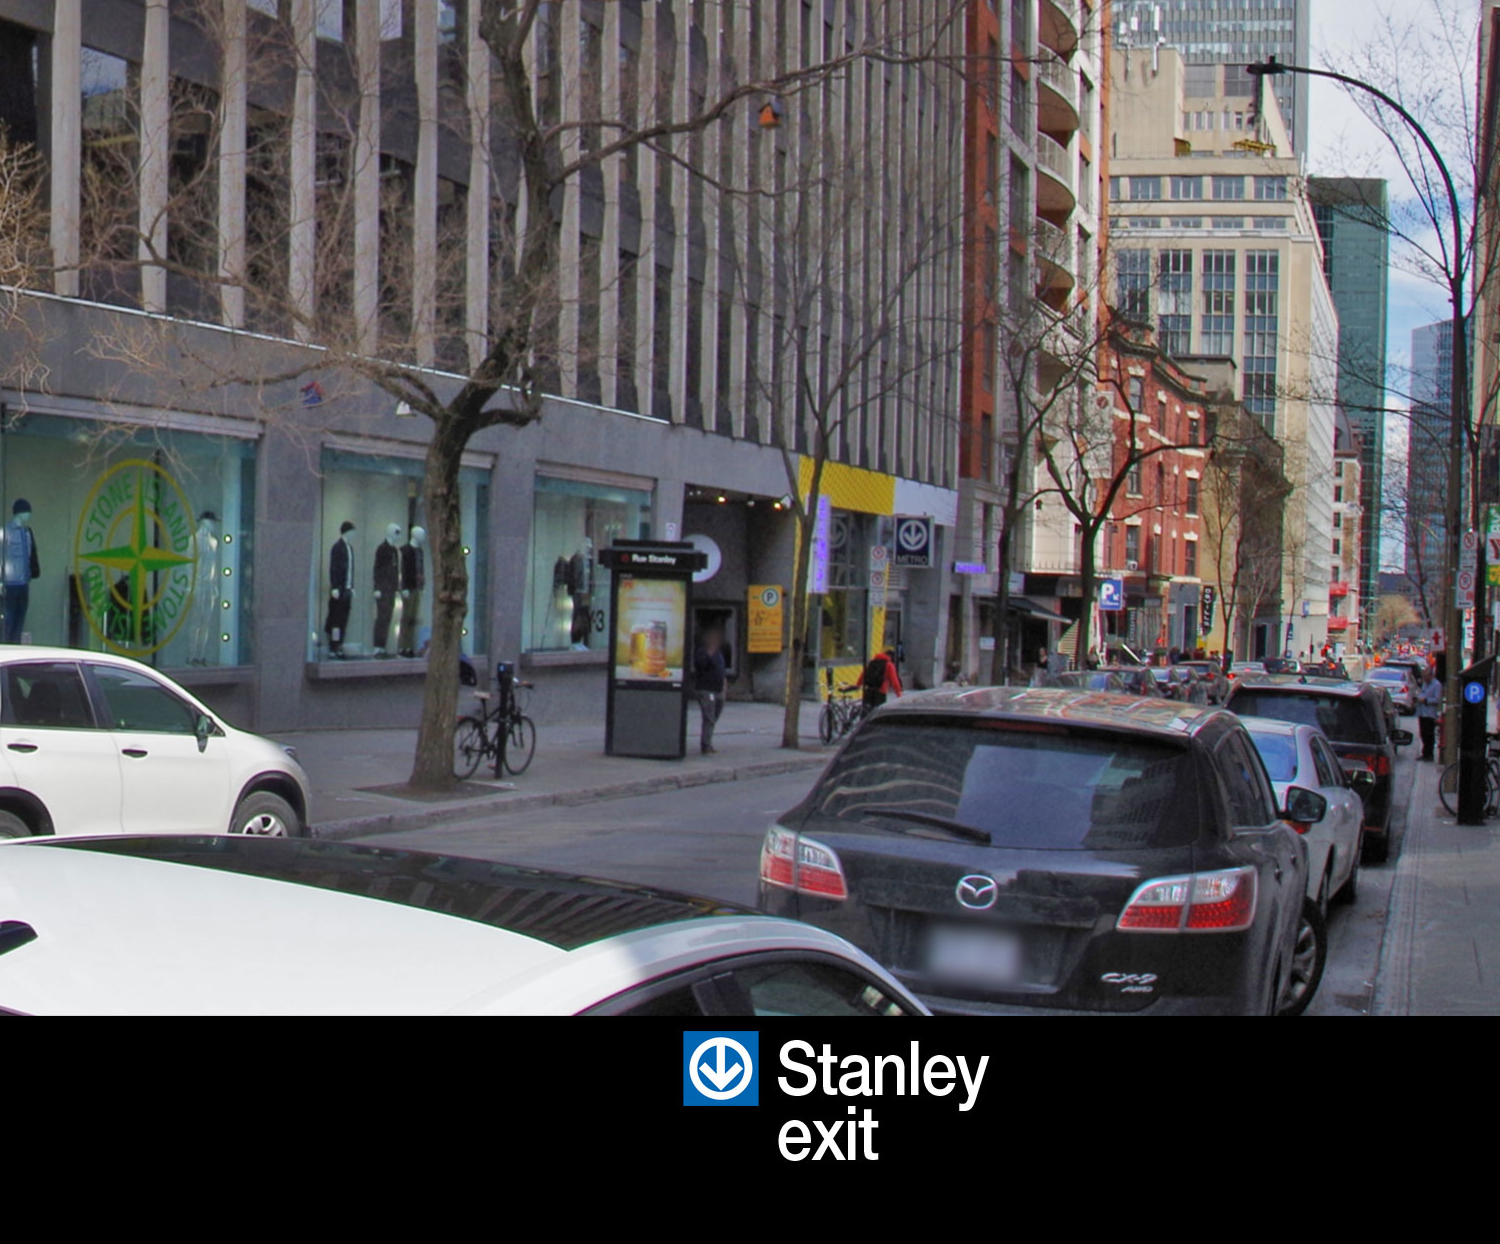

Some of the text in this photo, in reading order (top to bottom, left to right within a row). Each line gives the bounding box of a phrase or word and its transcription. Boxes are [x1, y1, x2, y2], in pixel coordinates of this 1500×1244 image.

[631, 553, 677, 565] Rue Stanley
[1100, 971, 1158, 985] CX-9
